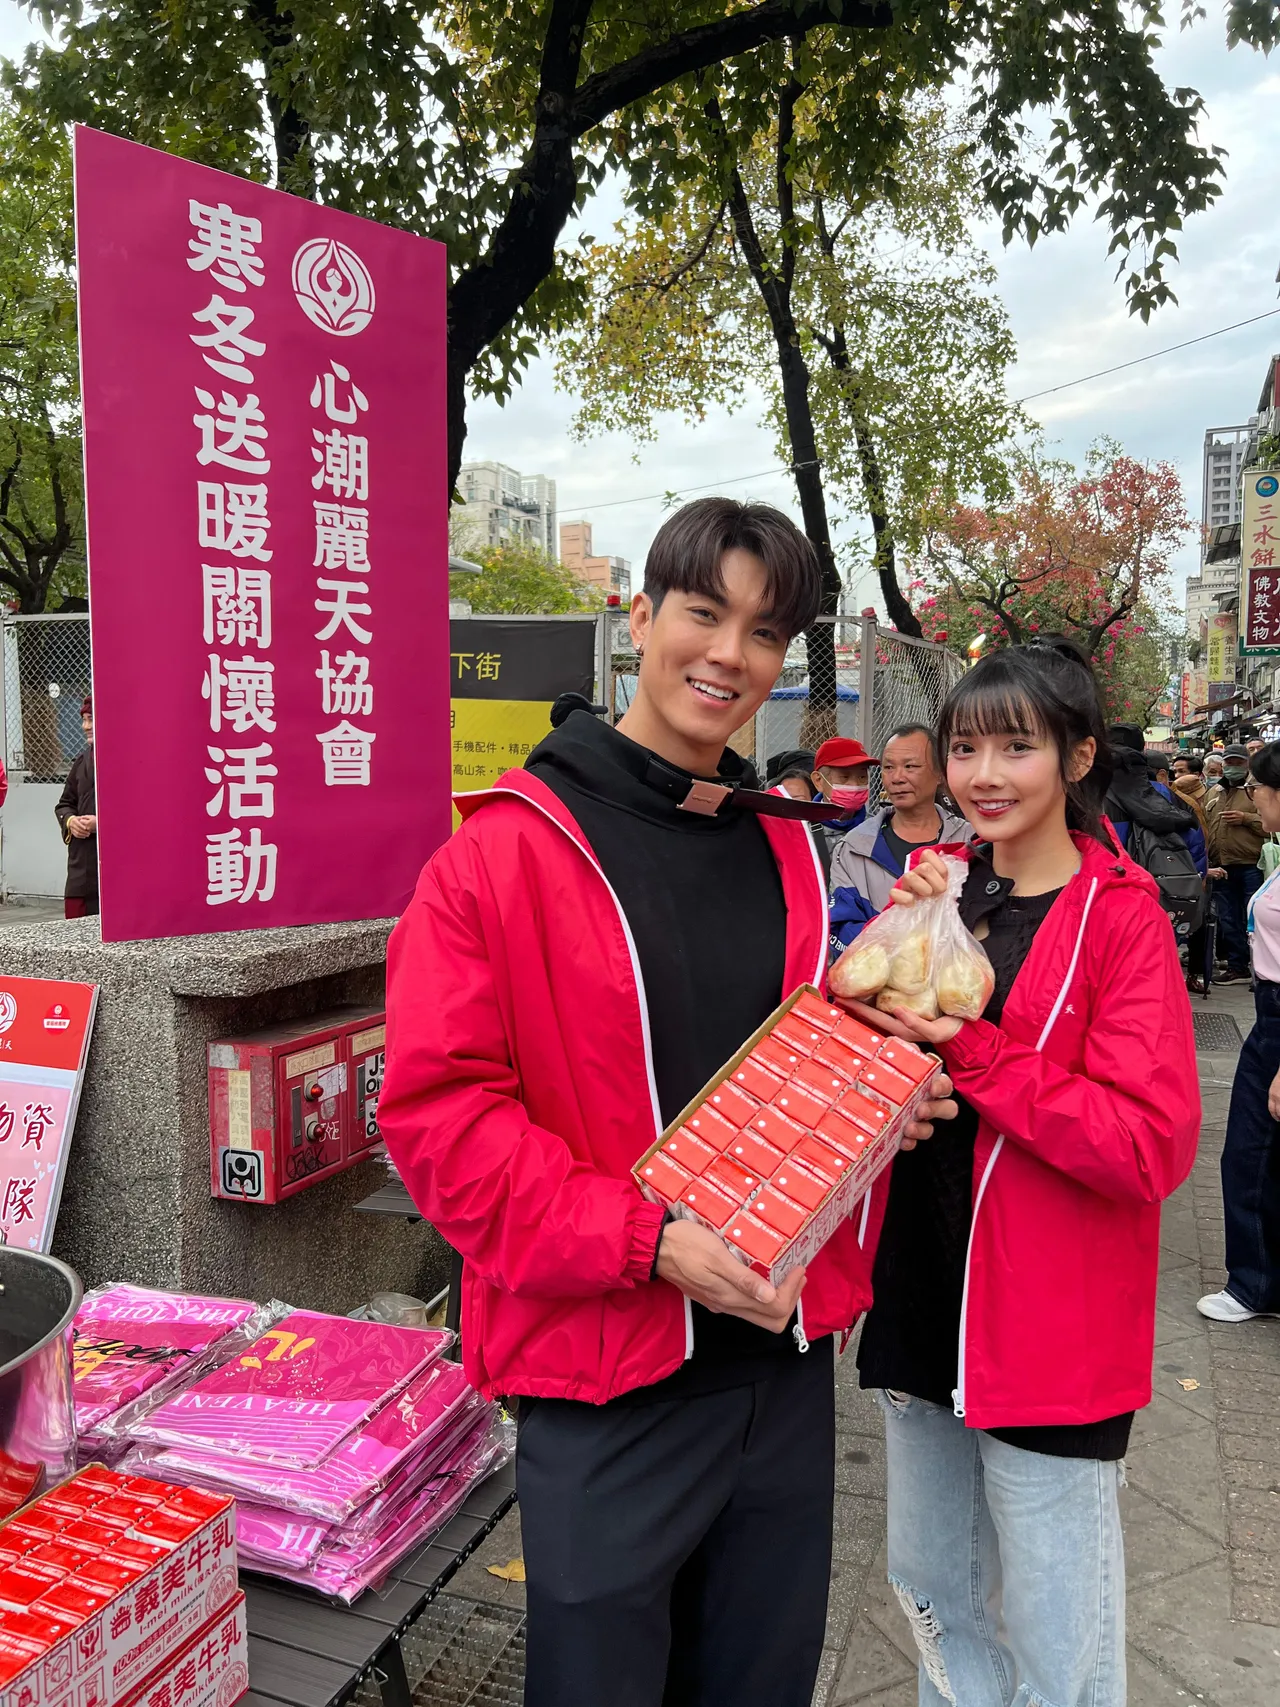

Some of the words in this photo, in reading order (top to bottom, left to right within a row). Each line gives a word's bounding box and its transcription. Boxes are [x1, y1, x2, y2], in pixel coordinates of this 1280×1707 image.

[187, 199, 278, 905] 寒冬送暖關懷活動
[310, 359, 376, 786] 心潮麗天協會
[1252, 576, 1272, 641] 佛教文物
[451, 653, 501, 680] 下街
[135, 1517, 234, 1625] 義美牛乳
[140, 1607, 168, 1635] I-mei
